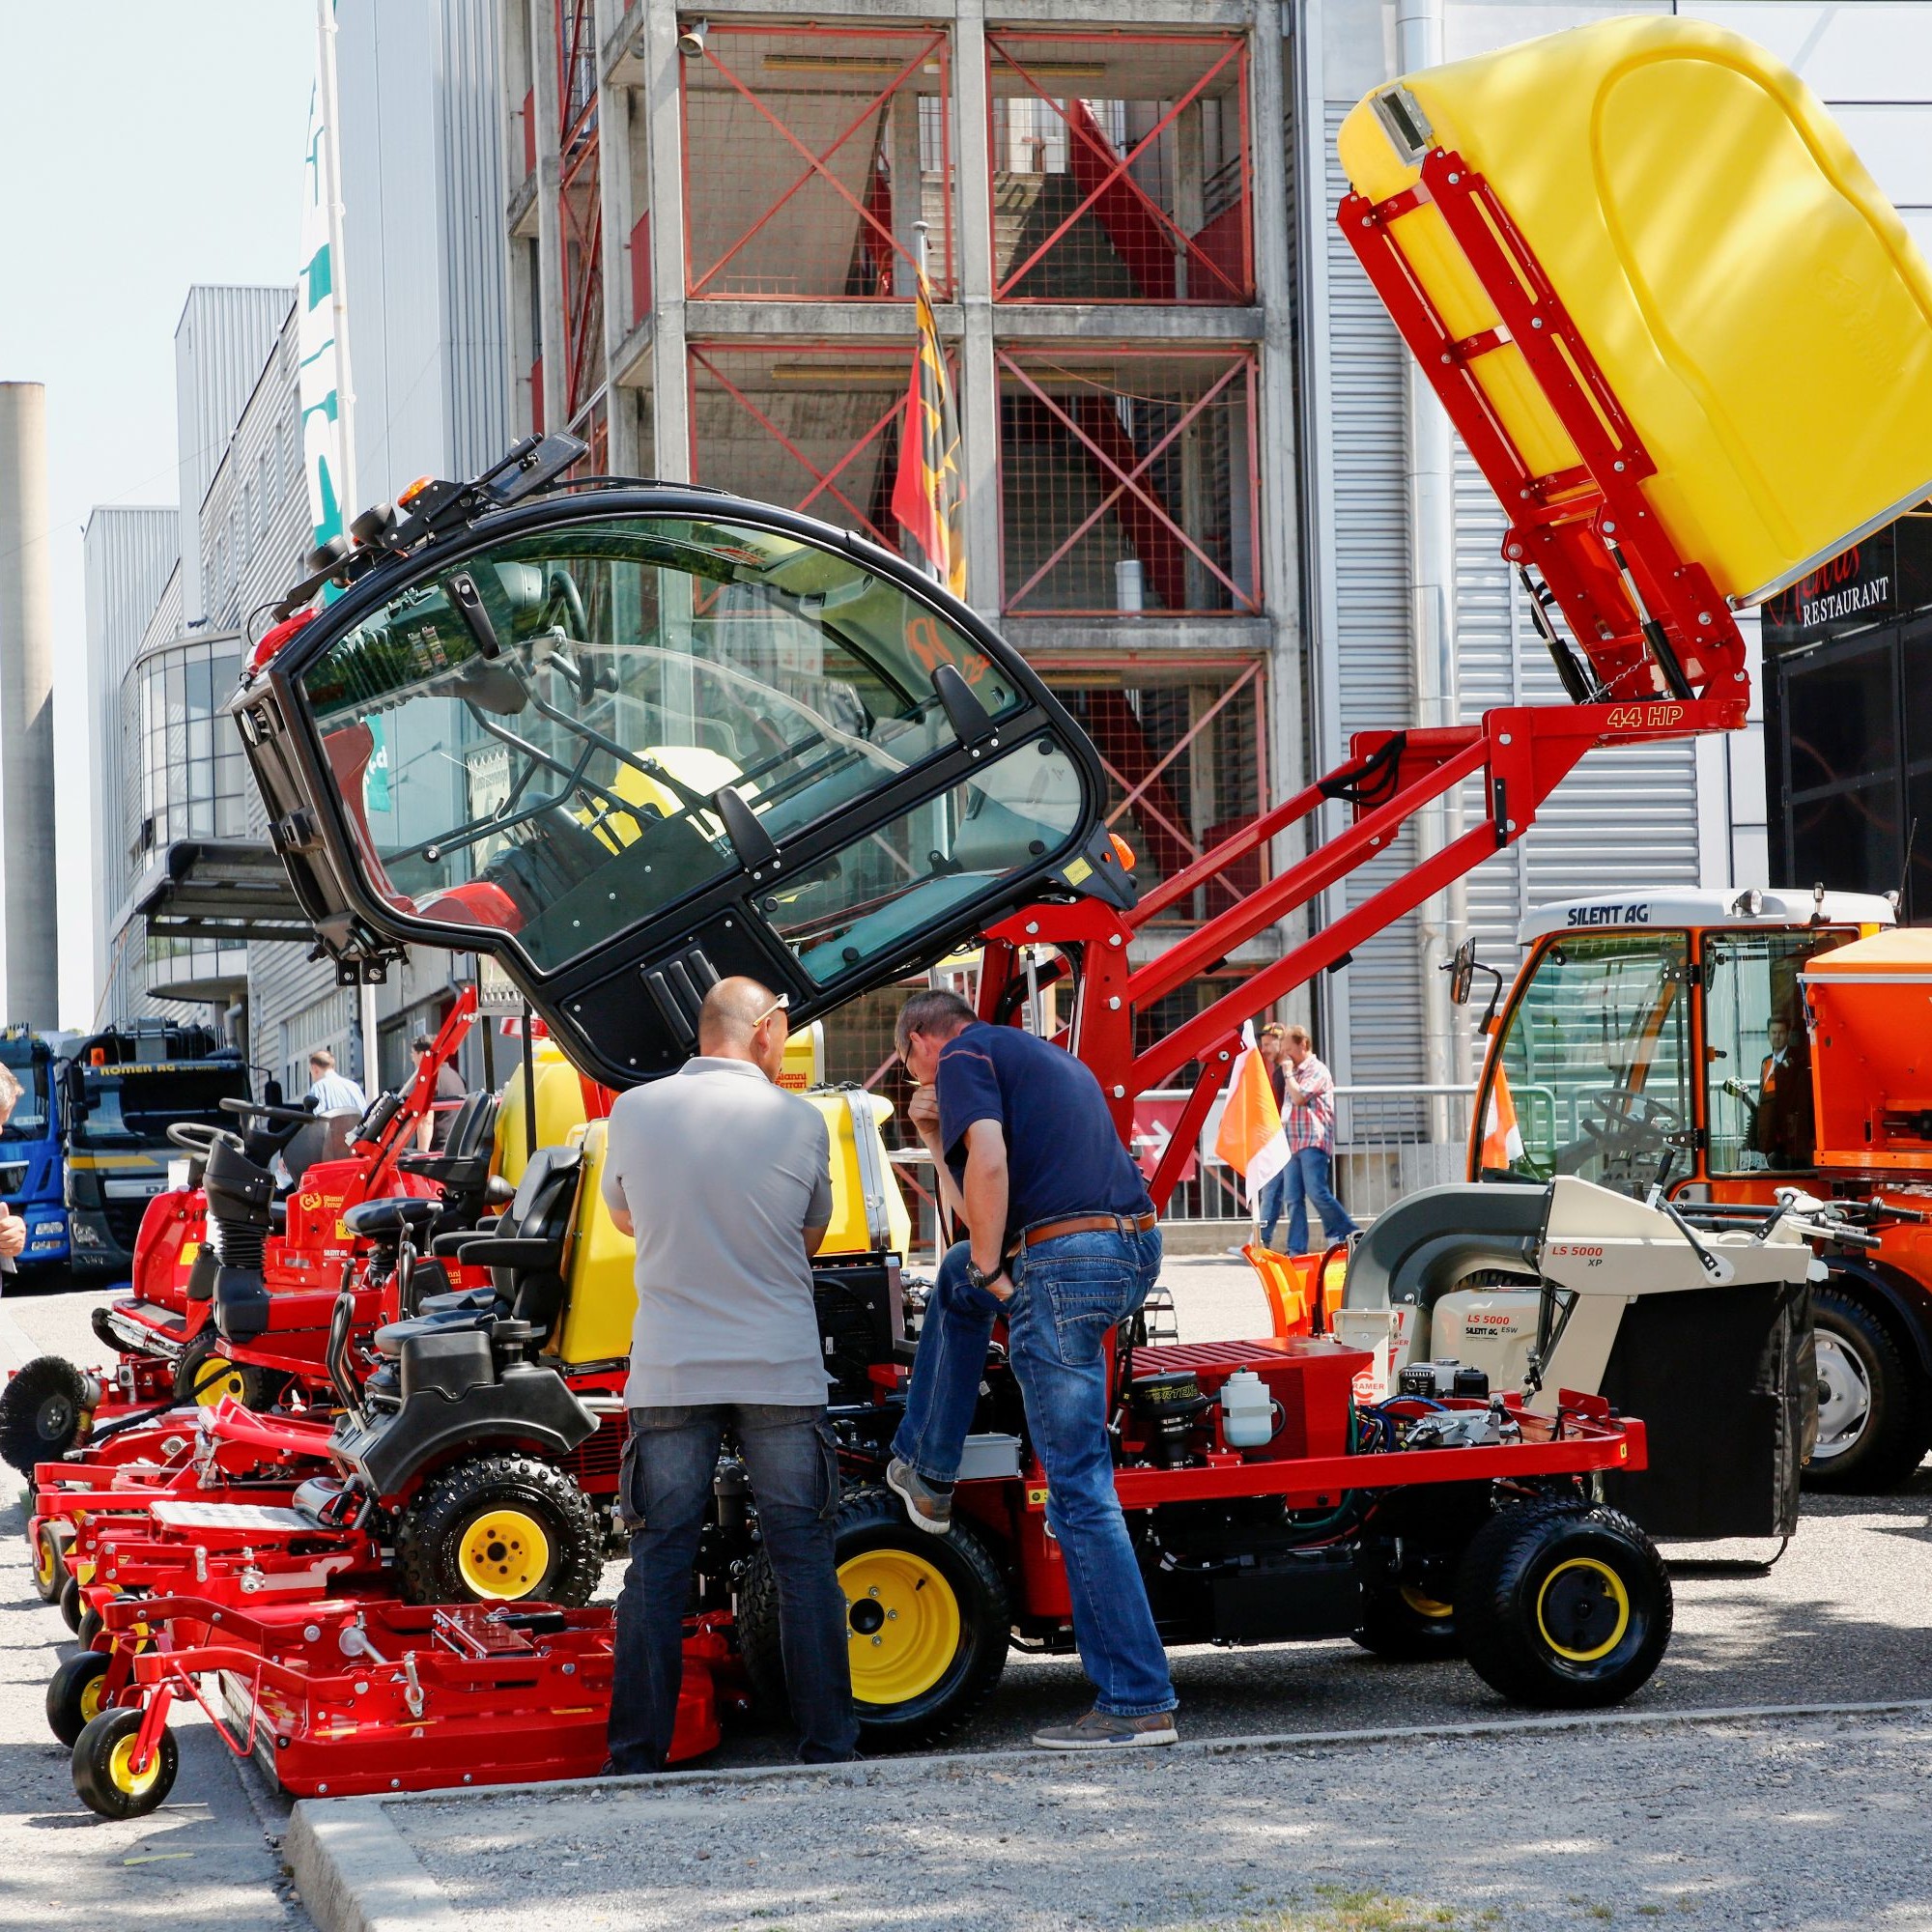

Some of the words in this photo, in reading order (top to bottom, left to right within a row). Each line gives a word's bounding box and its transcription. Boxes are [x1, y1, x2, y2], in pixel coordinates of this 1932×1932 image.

[1803, 576, 1889, 628] RESTAURANT
[1606, 707, 1642, 728] 44
[1647, 705, 1684, 726] HP
[1567, 905, 1623, 926] SILENT
[1624, 903, 1649, 923] AG
[1552, 1246, 1568, 1256] LS
[1571, 1246, 1604, 1257] 5000
[1587, 1259, 1603, 1267] XP
[1467, 1315, 1480, 1323] LS
[1483, 1315, 1510, 1325] 5000
